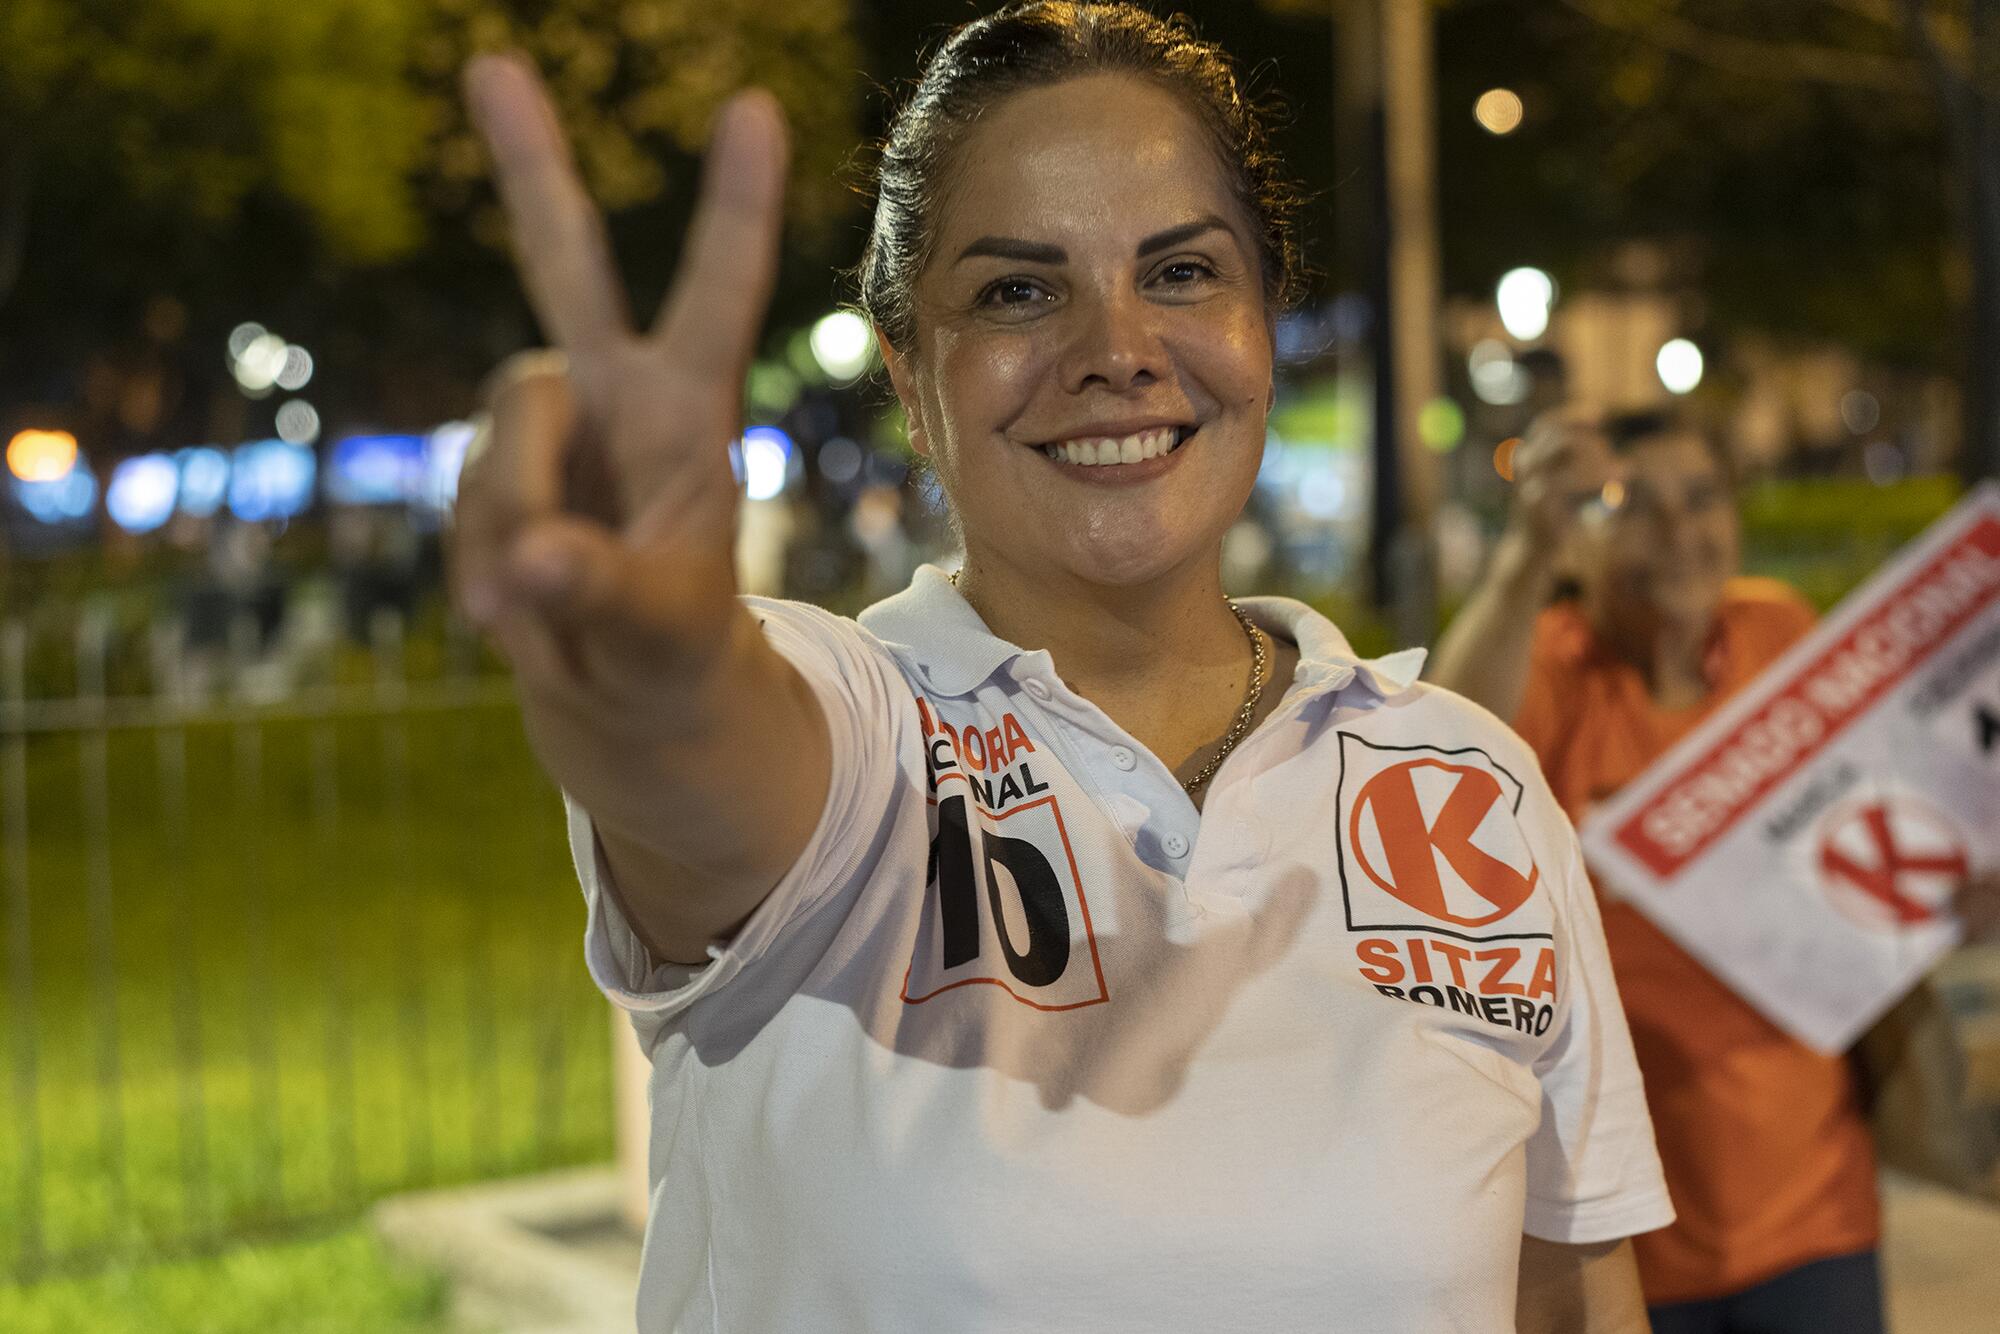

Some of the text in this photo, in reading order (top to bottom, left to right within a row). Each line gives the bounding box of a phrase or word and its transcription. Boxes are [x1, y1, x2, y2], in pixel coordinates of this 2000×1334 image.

[1353, 759, 1537, 926] K
[1819, 804, 1969, 926] K
[1356, 938, 1557, 1004] SITZA
[1373, 984, 1554, 1038] ROMERO
